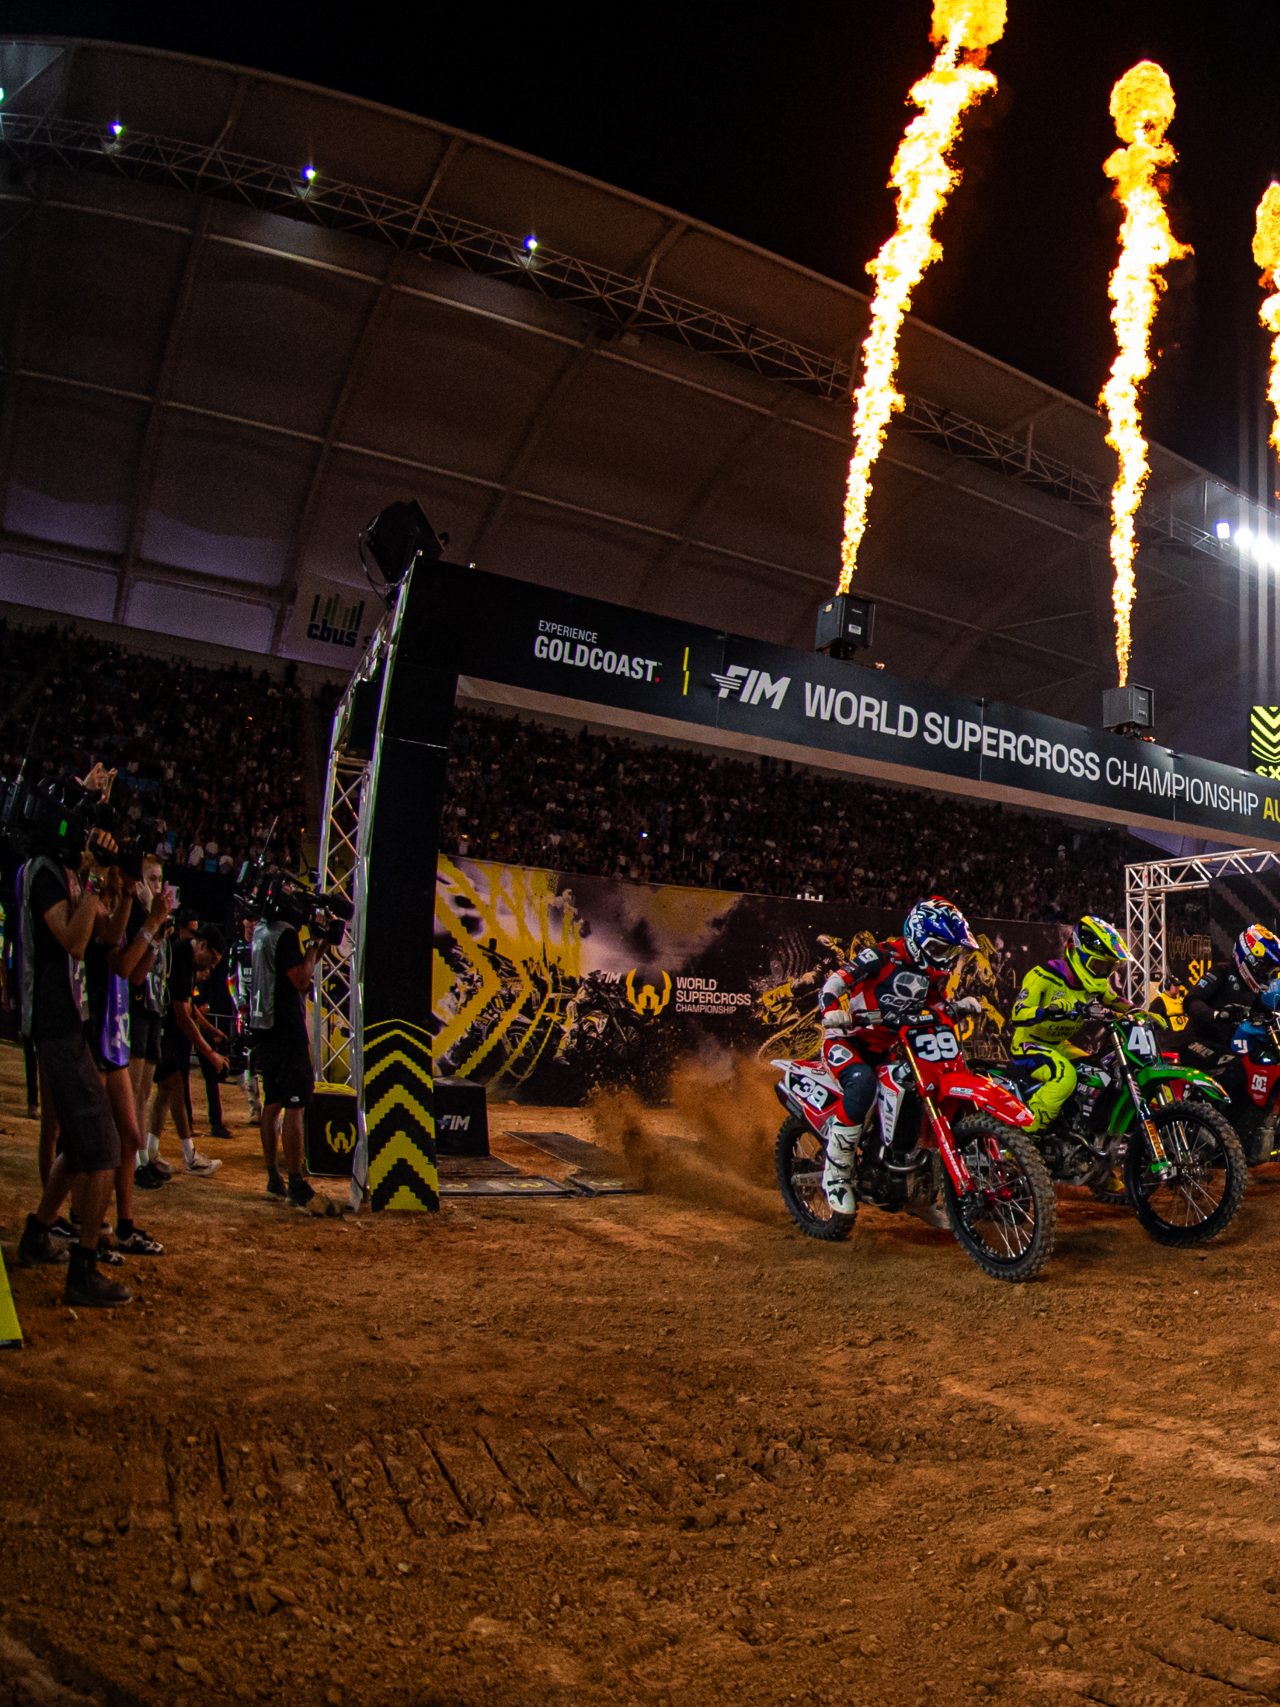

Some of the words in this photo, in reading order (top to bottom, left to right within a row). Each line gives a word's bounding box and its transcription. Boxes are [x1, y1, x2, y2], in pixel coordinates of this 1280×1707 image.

[538, 620, 598, 643] EXPERIENCE
[711, 664, 792, 710] FIM
[804, 681, 918, 738] WORLD
[923, 711, 1101, 781] SUPERCROSS
[1105, 757, 1259, 816] CHAMPIONSHIP
[676, 976, 717, 991] WORLD
[675, 989, 752, 1006] SUPERCROSS
[675, 1004, 737, 1015] CHAMPIONSHIP
[915, 1031, 959, 1062] 39
[1127, 1026, 1157, 1057] 41
[437, 1114, 471, 1132] FIM
